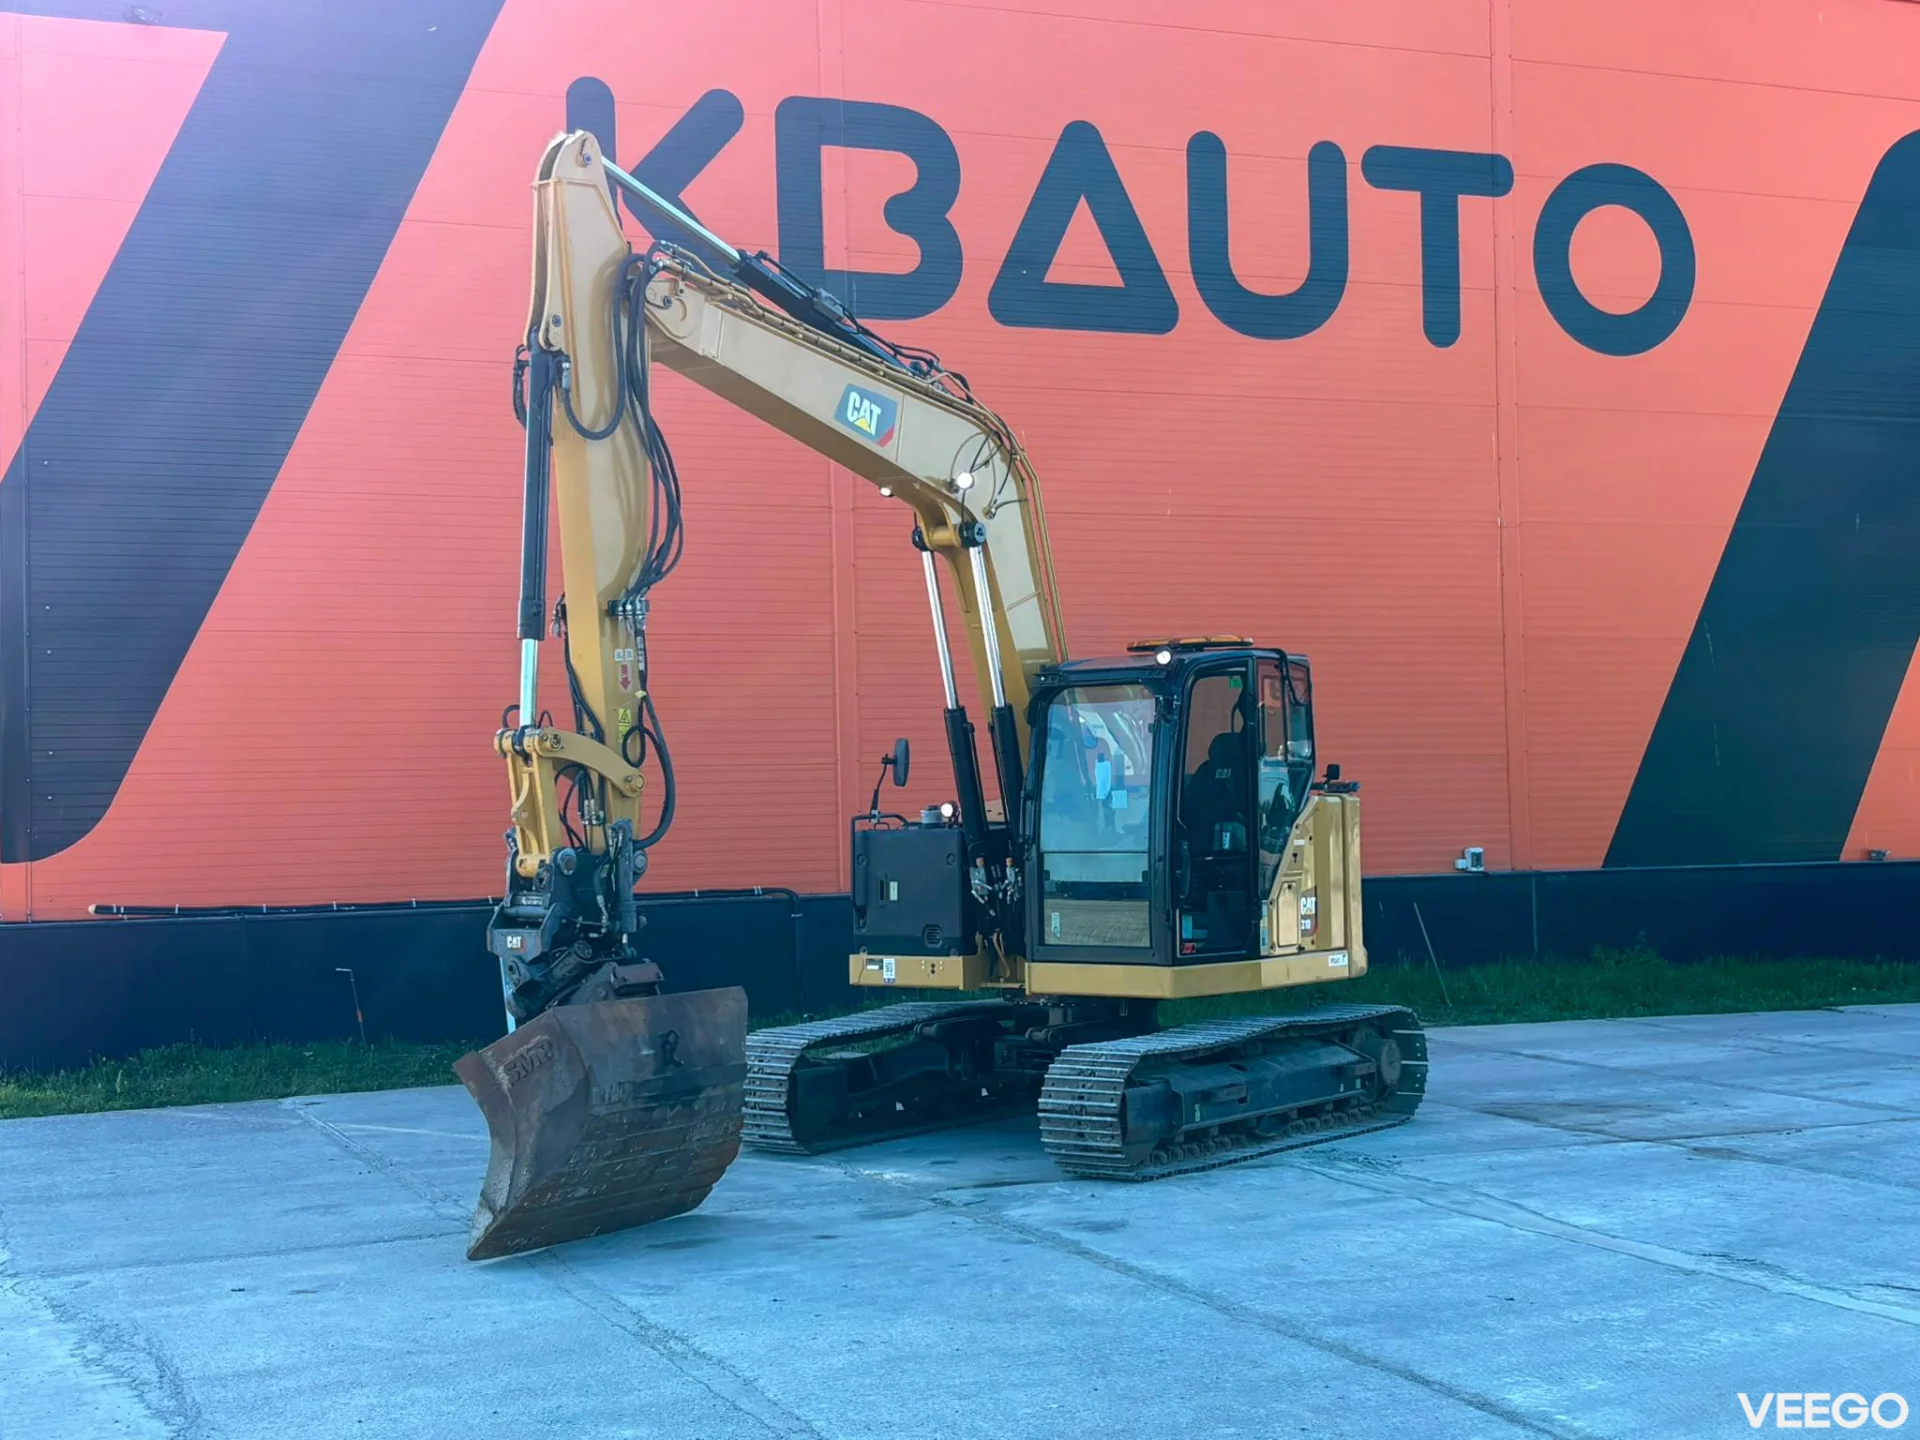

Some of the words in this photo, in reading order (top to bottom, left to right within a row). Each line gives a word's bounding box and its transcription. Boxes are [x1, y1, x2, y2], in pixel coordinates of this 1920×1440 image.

[847, 391, 882, 435] CAT
[1301, 897, 1316, 915] CAT
[507, 936, 522, 948] CAT
